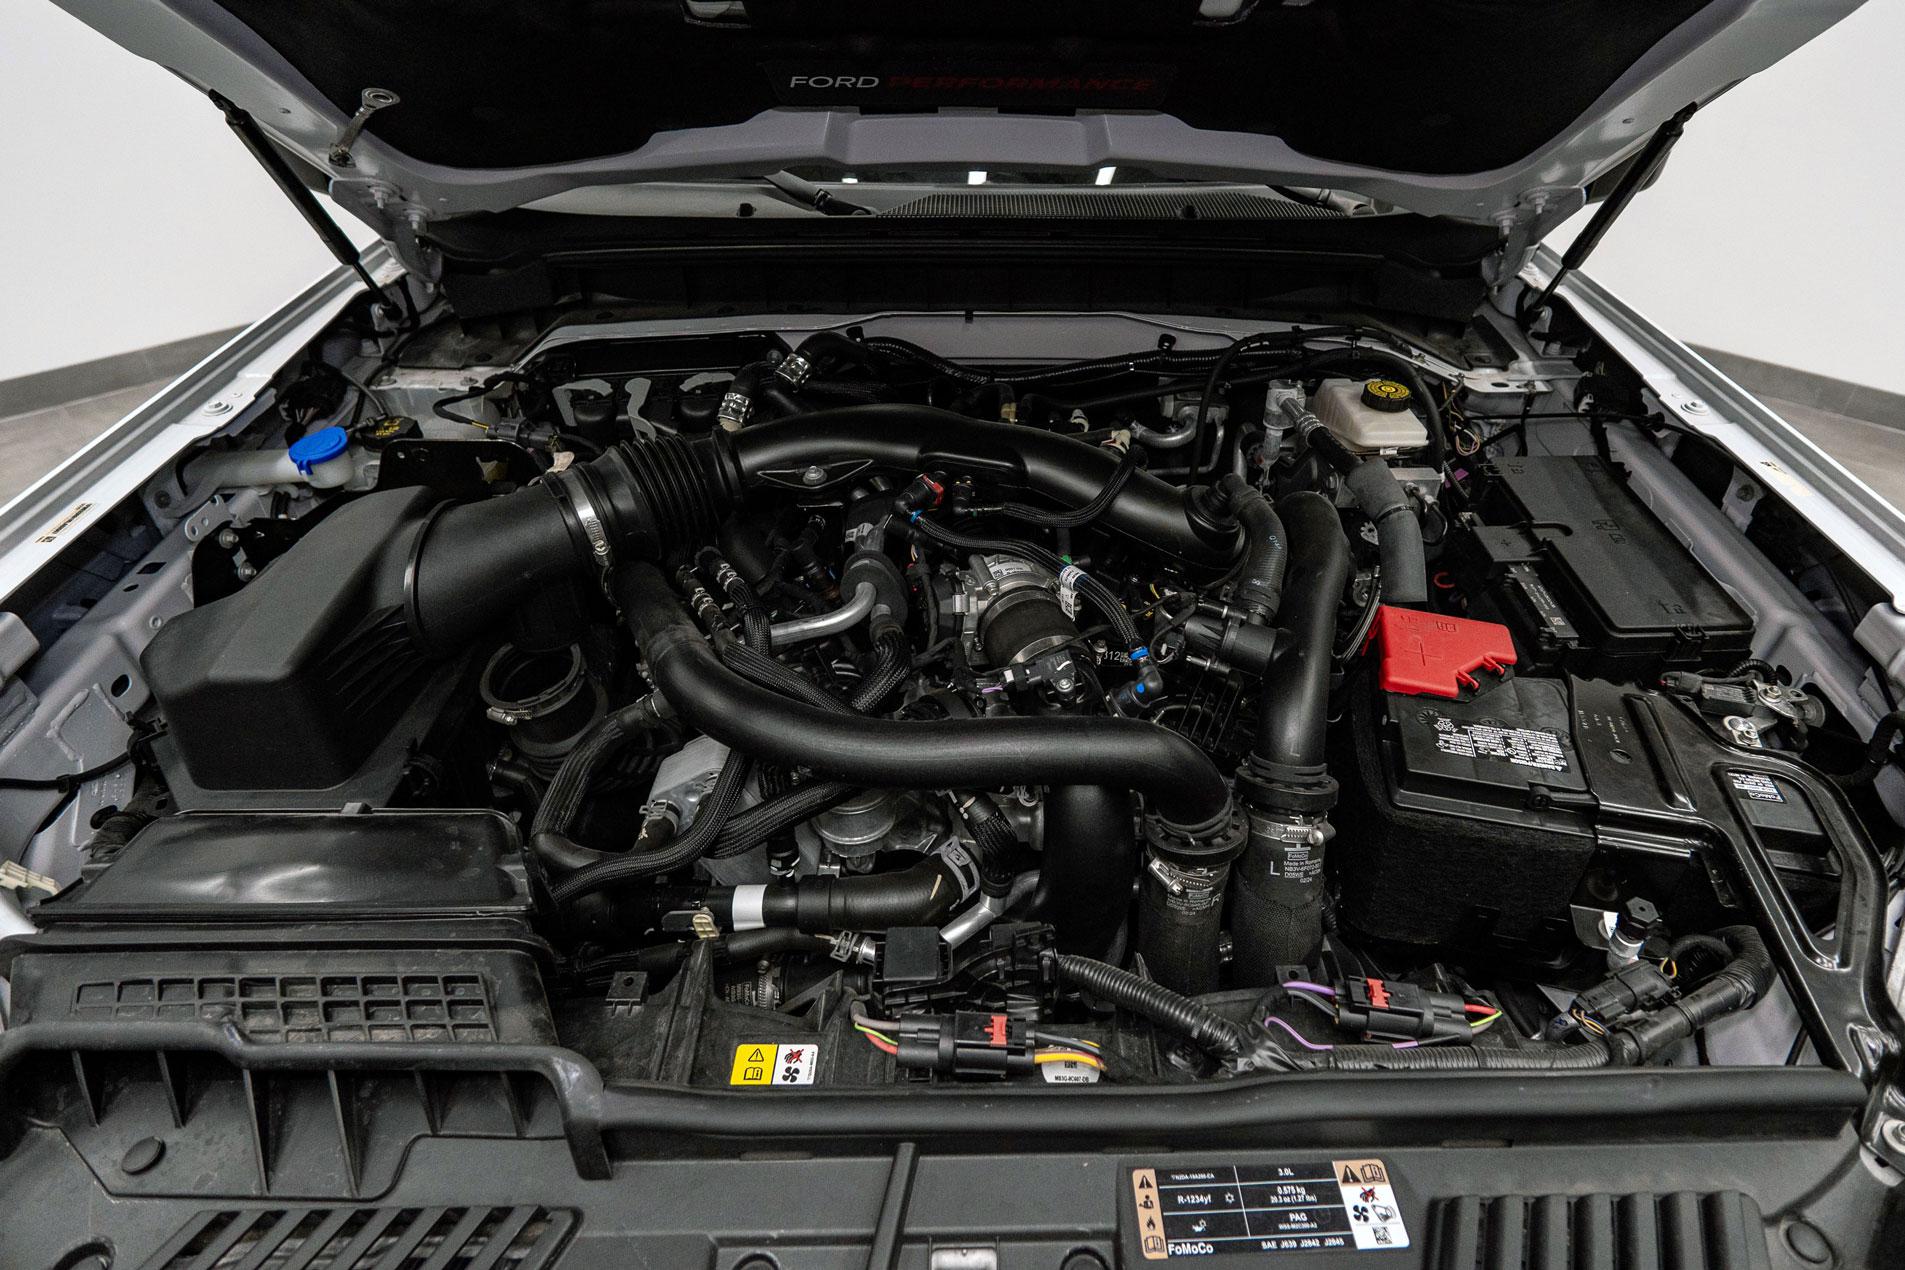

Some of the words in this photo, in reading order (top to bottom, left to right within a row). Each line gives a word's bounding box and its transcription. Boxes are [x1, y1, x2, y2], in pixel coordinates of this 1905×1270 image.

[789, 75, 880, 89] FORD
[887, 75, 1155, 92] PERFORMANCE
[1270, 860, 1281, 876] L
[1277, 1167, 1295, 1176] 3.0L
[1296, 1185, 1306, 1195] kg
[1177, 1194, 1212, 1205] R-1234yf
[1288, 1212, 1308, 1222] PAG
[1167, 1242, 1214, 1256] FoMoCo
[1261, 1240, 1278, 1249] SAE
